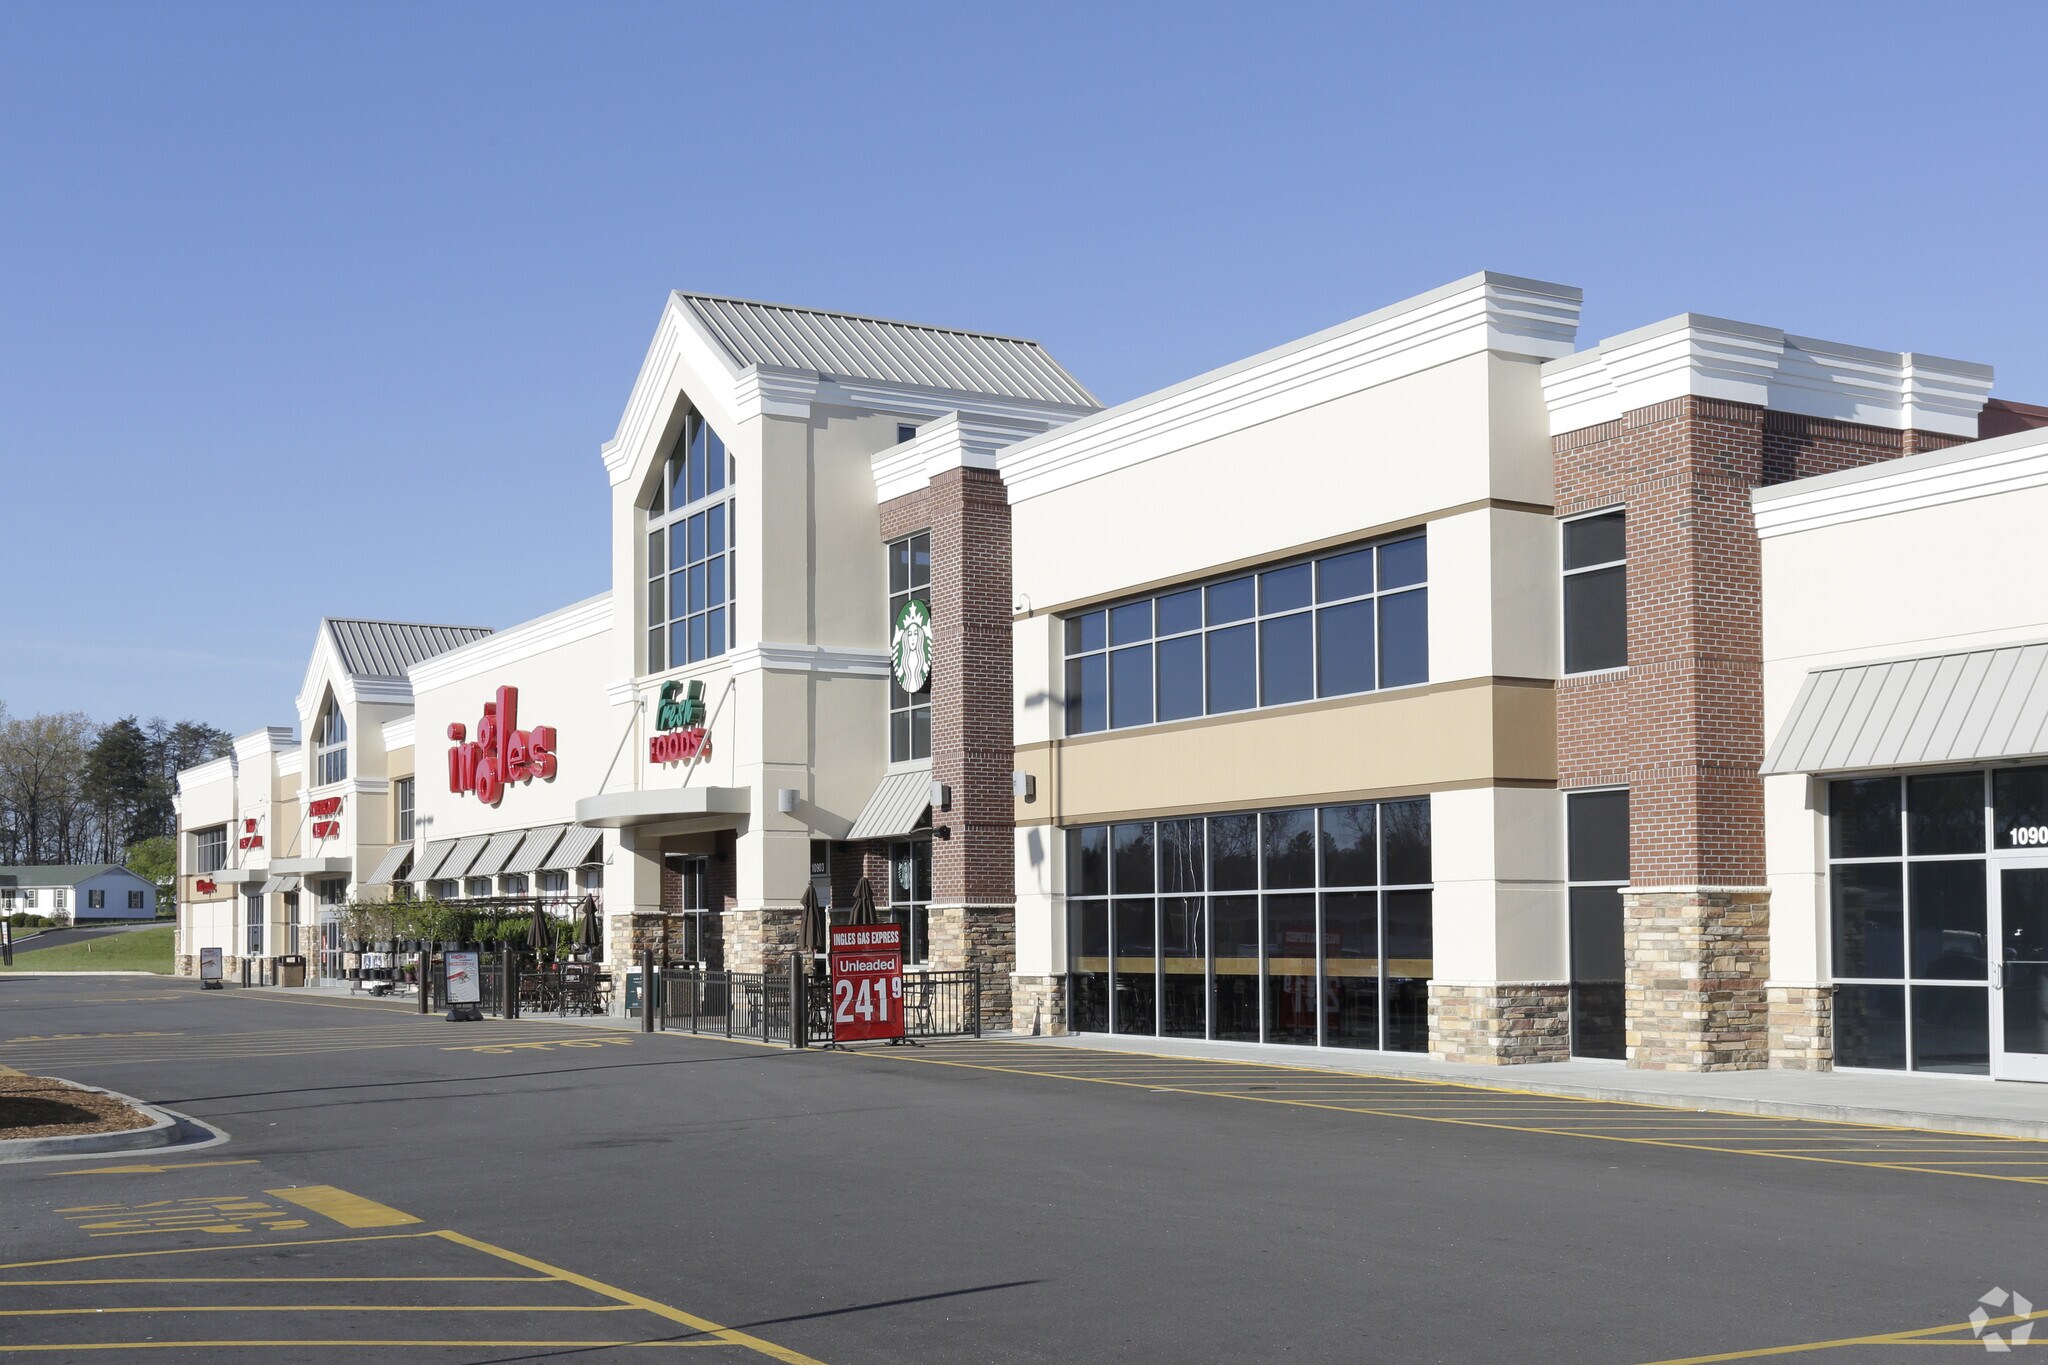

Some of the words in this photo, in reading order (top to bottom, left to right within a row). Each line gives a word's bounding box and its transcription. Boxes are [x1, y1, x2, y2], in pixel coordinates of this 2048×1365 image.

[655, 680, 704, 731] Fresh
[447, 685, 557, 805] ingles
[649, 728, 709, 763] FOODS
[833, 932, 856, 946] INGLES
[857, 931, 870, 945] GAS
[871, 930, 899, 944] EXPRESS
[840, 958, 895, 973] Unleaded
